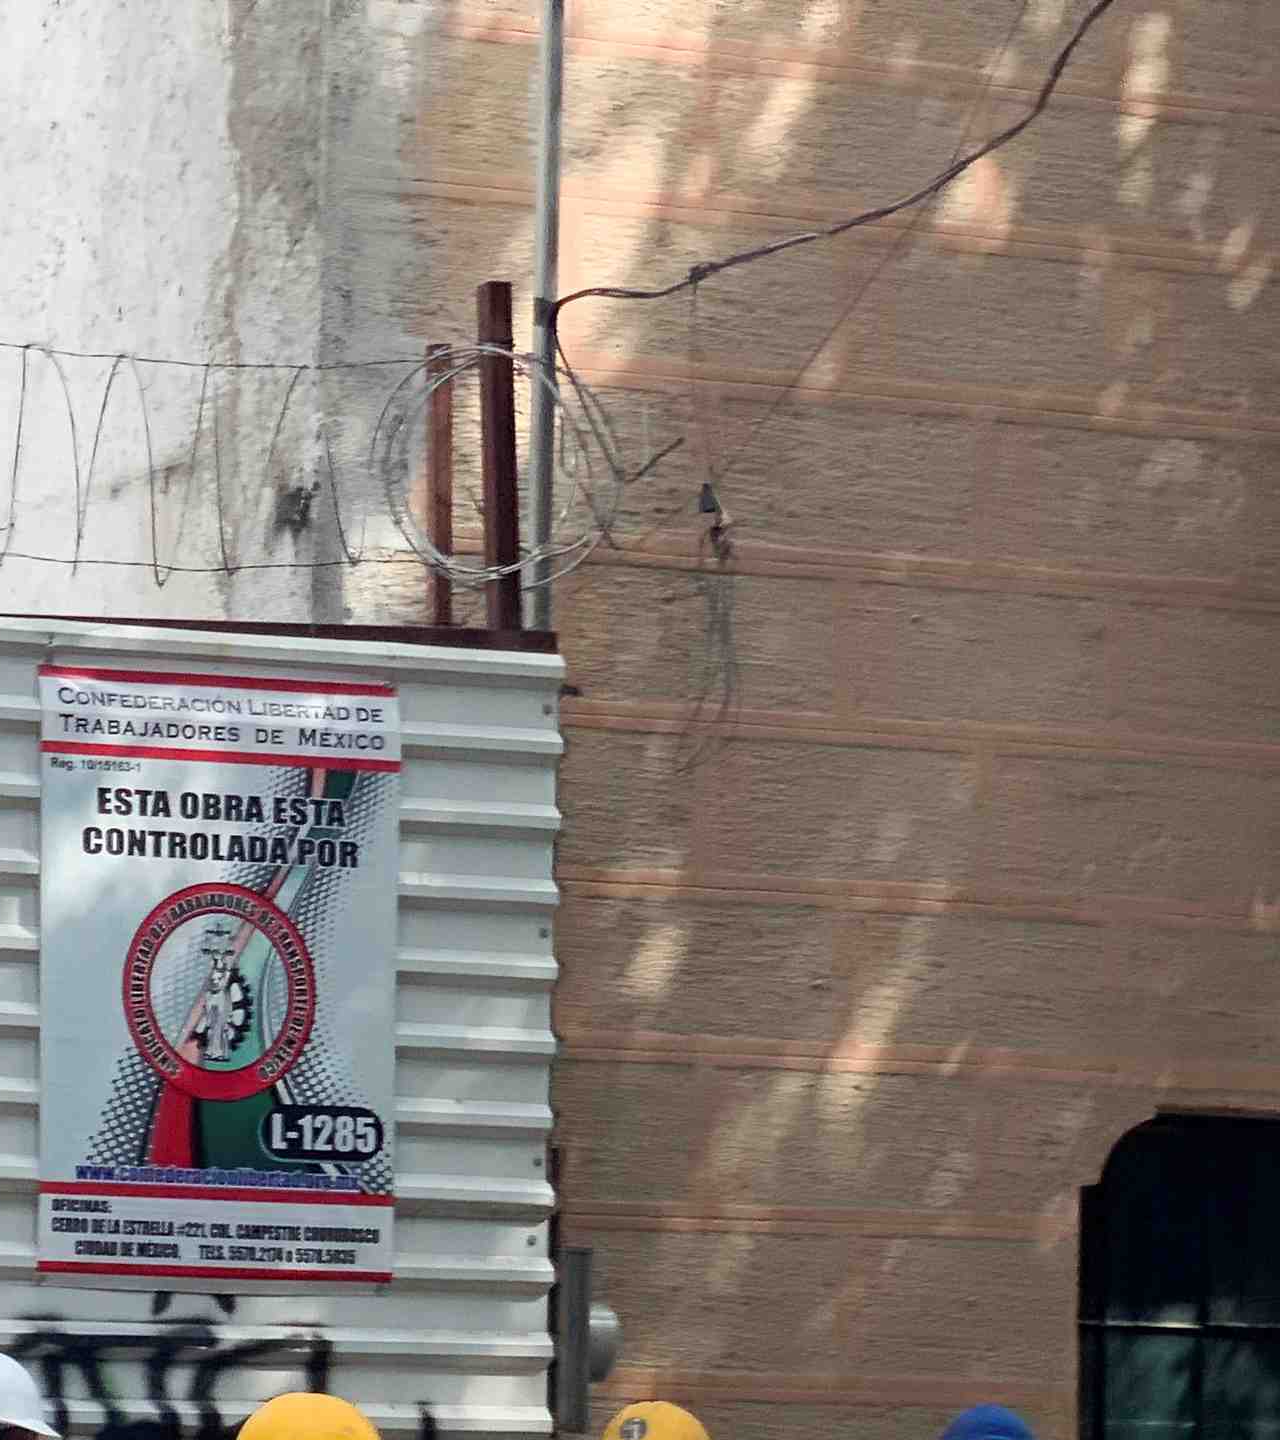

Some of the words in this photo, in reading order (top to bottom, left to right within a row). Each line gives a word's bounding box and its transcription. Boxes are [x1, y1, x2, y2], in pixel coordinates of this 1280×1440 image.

[248, 699, 348, 722] LIBERTAD
[356, 707, 384, 723] DE
[58, 714, 240, 742] TRABAJADORES
[255, 728, 284, 744] DE
[298, 727, 384, 751] MÉXICO
[97, 787, 170, 819] ESTA
[180, 792, 263, 823] OBRA
[273, 797, 346, 828] ESTA
[82, 827, 288, 864] CONTROLADA
[297, 839, 359, 868] POR
[271, 1113, 378, 1153] L-1285
